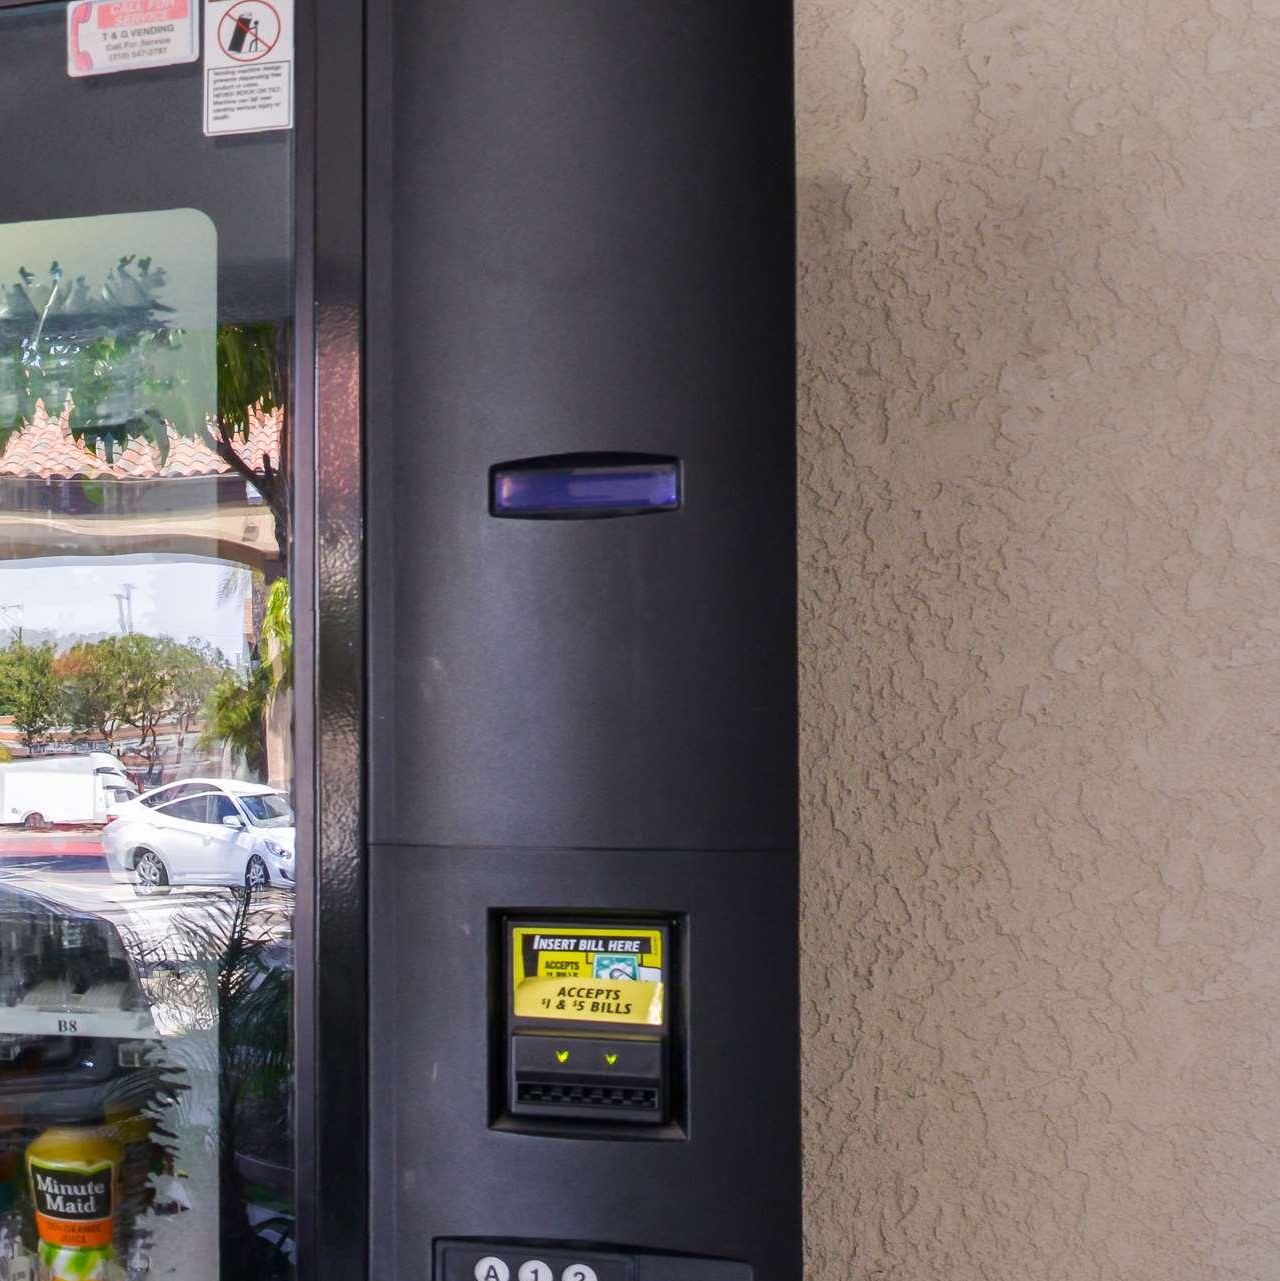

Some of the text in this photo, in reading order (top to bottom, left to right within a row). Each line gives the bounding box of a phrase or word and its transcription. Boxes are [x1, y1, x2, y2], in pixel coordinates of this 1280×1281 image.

[131, 24, 175, 37] VENDING
[533, 935, 641, 952] INSERT BILL HERE
[545, 960, 580, 970] ACCEPTS
[557, 986, 622, 1000] ACCEPTS
[541, 998, 633, 1015] $1 & $5 BILLS
[58, 1020, 77, 1032] B8
[35, 1174, 105, 1197] Minute
[46, 1194, 96, 1214] Maid
